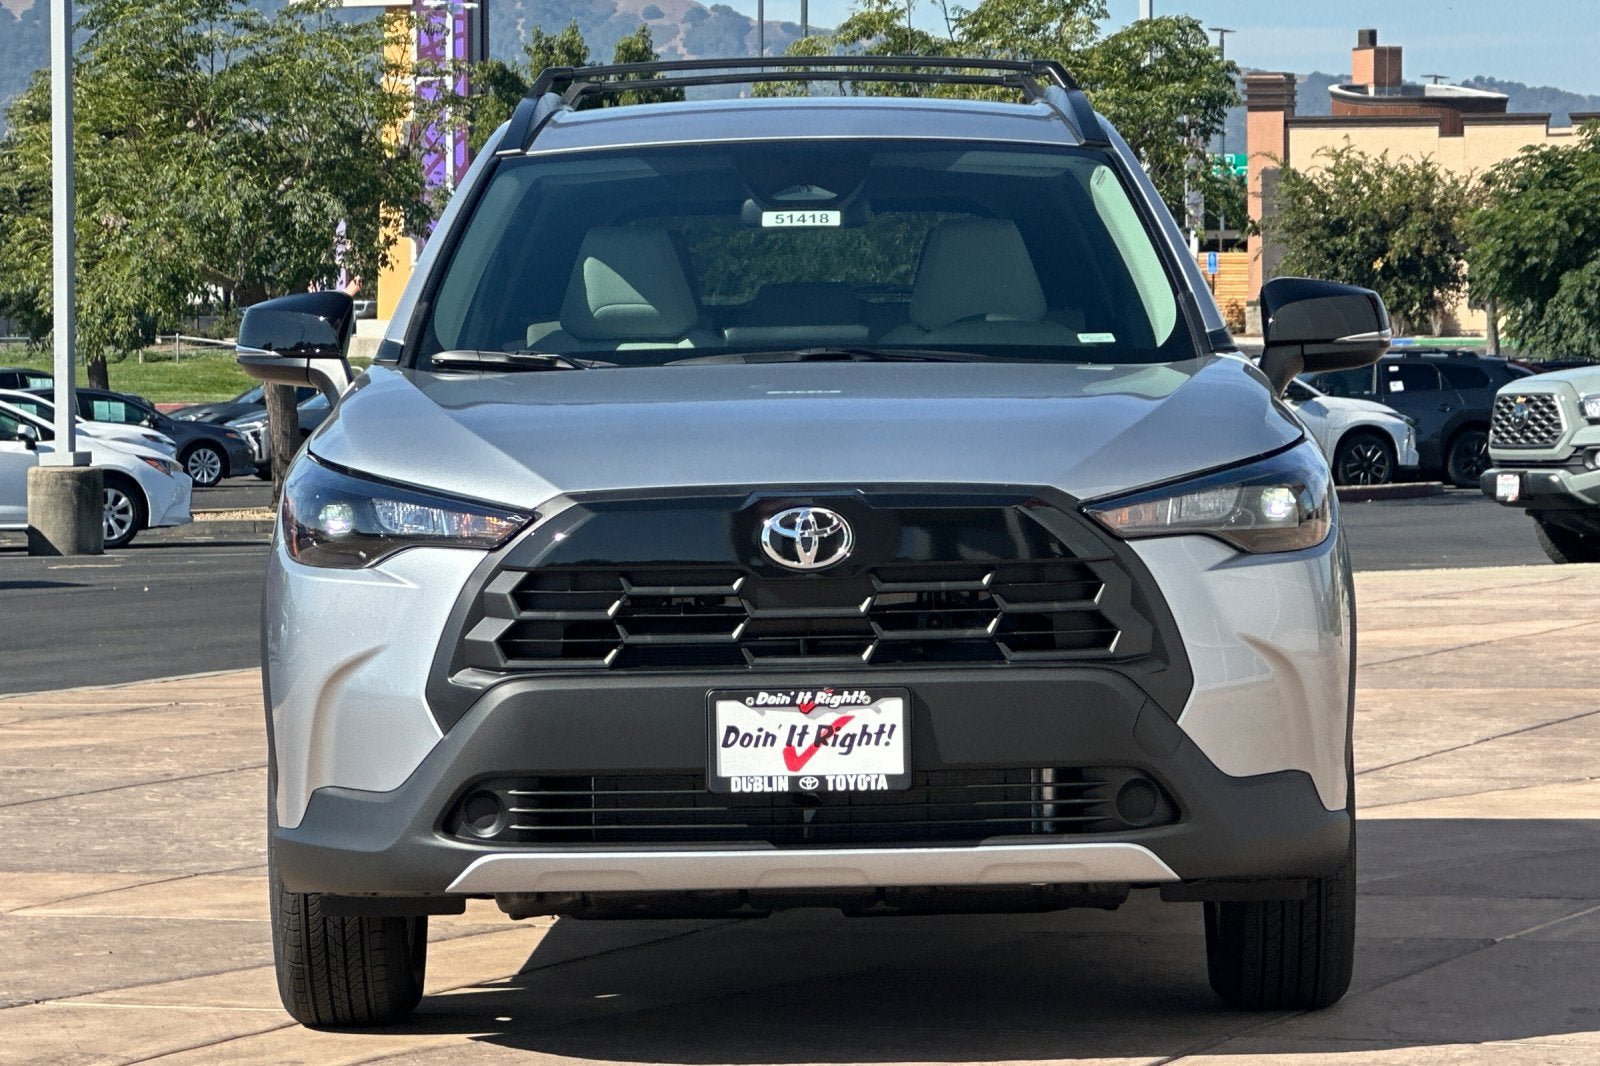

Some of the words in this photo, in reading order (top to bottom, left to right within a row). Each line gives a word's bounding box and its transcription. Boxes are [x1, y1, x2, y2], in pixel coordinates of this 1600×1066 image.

[775, 213, 829, 225] 51418
[756, 691, 795, 705] Doin'
[796, 691, 812, 704] It
[812, 690, 865, 707] Right!
[721, 724, 783, 748] Doin'
[786, 724, 810, 747] It
[814, 724, 896, 755] Right!
[730, 776, 789, 793] DUBLIN
[826, 774, 888, 791] TOYOTA
